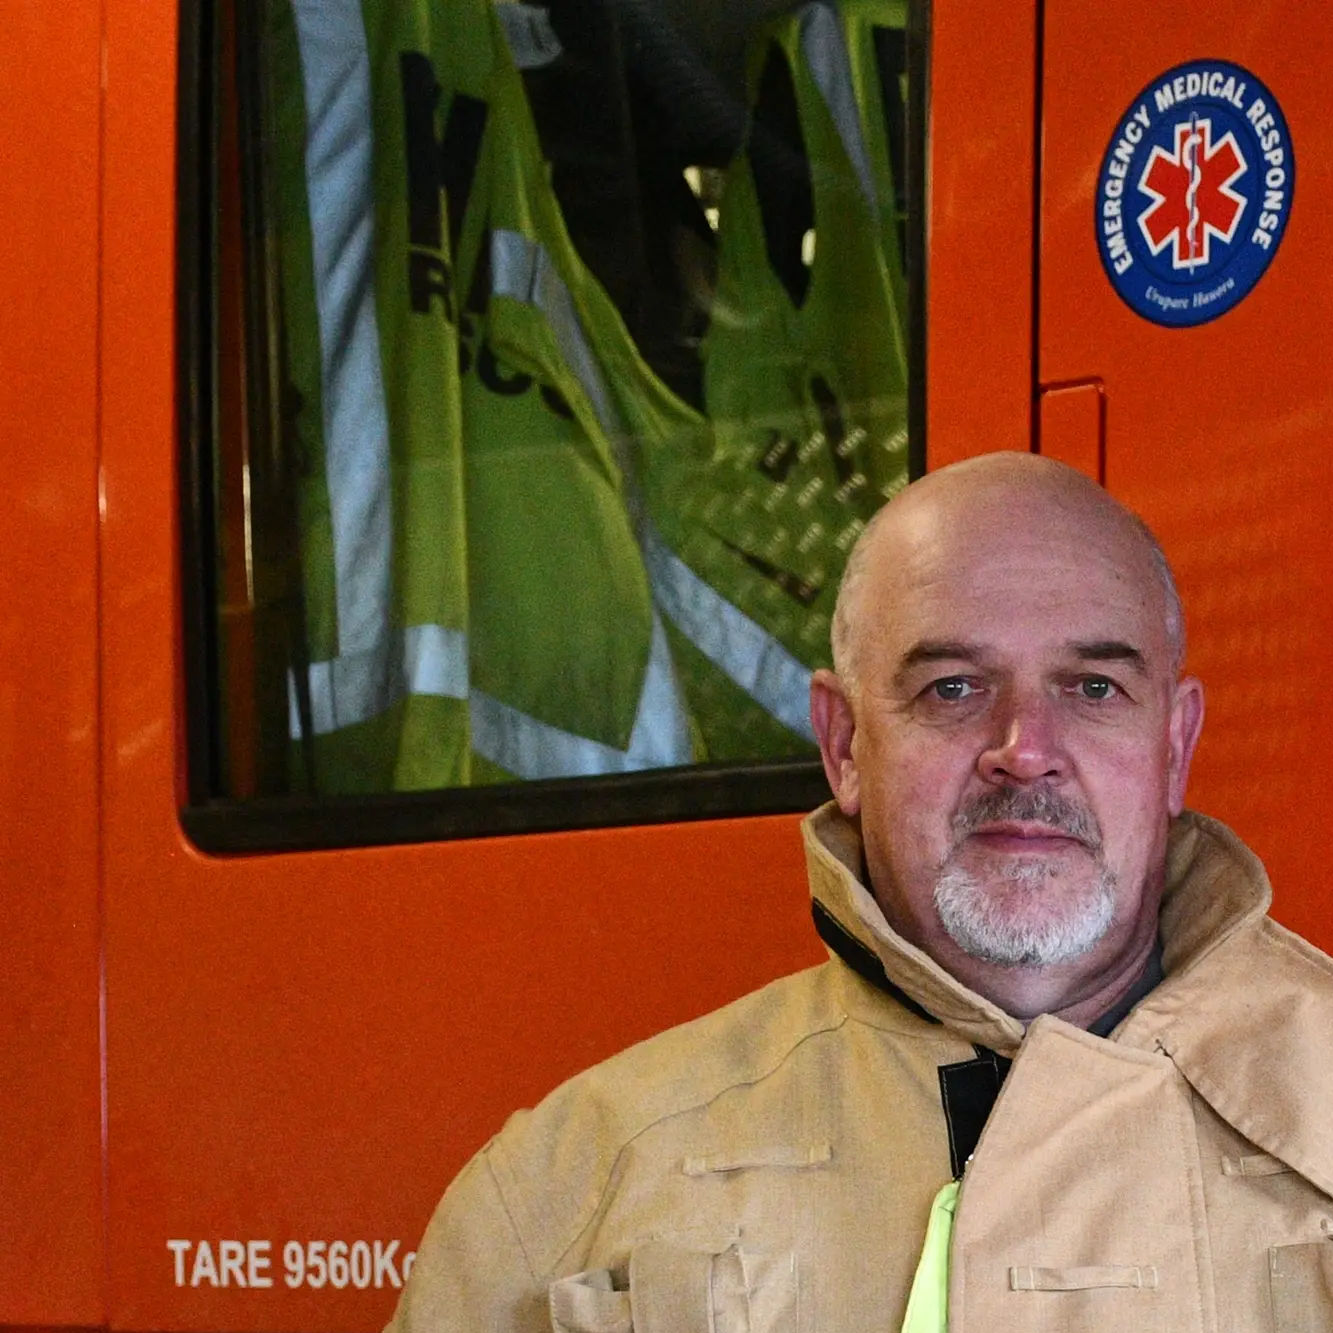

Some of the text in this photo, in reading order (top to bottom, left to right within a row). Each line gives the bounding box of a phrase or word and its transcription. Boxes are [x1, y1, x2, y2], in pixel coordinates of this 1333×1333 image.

[1103, 71, 1286, 275] EMERGENCY MEDICAL RESPONSE
[166, 1239, 273, 1288] TARE
